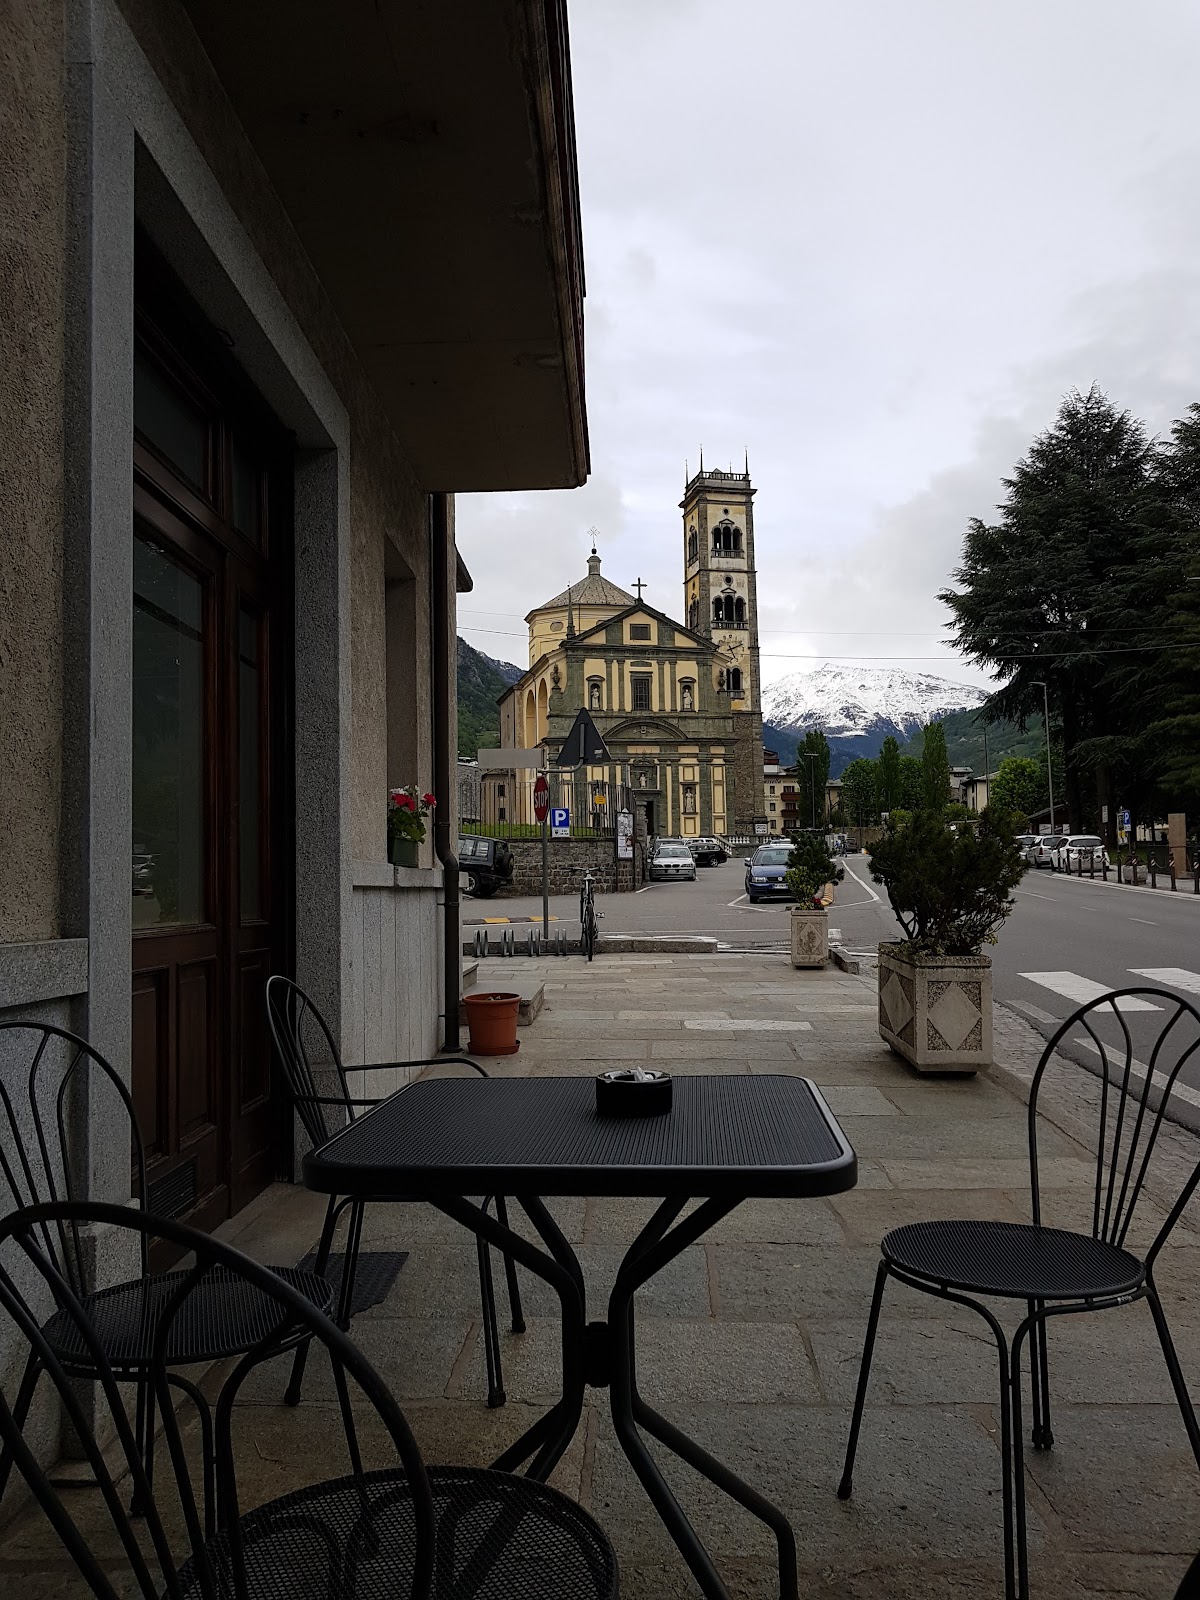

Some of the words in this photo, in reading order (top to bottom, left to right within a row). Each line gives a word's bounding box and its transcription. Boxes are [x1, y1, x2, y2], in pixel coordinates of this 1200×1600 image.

[534, 790, 548, 808] STOP
[555, 810, 566, 826] P
[1124, 812, 1130, 823] P
